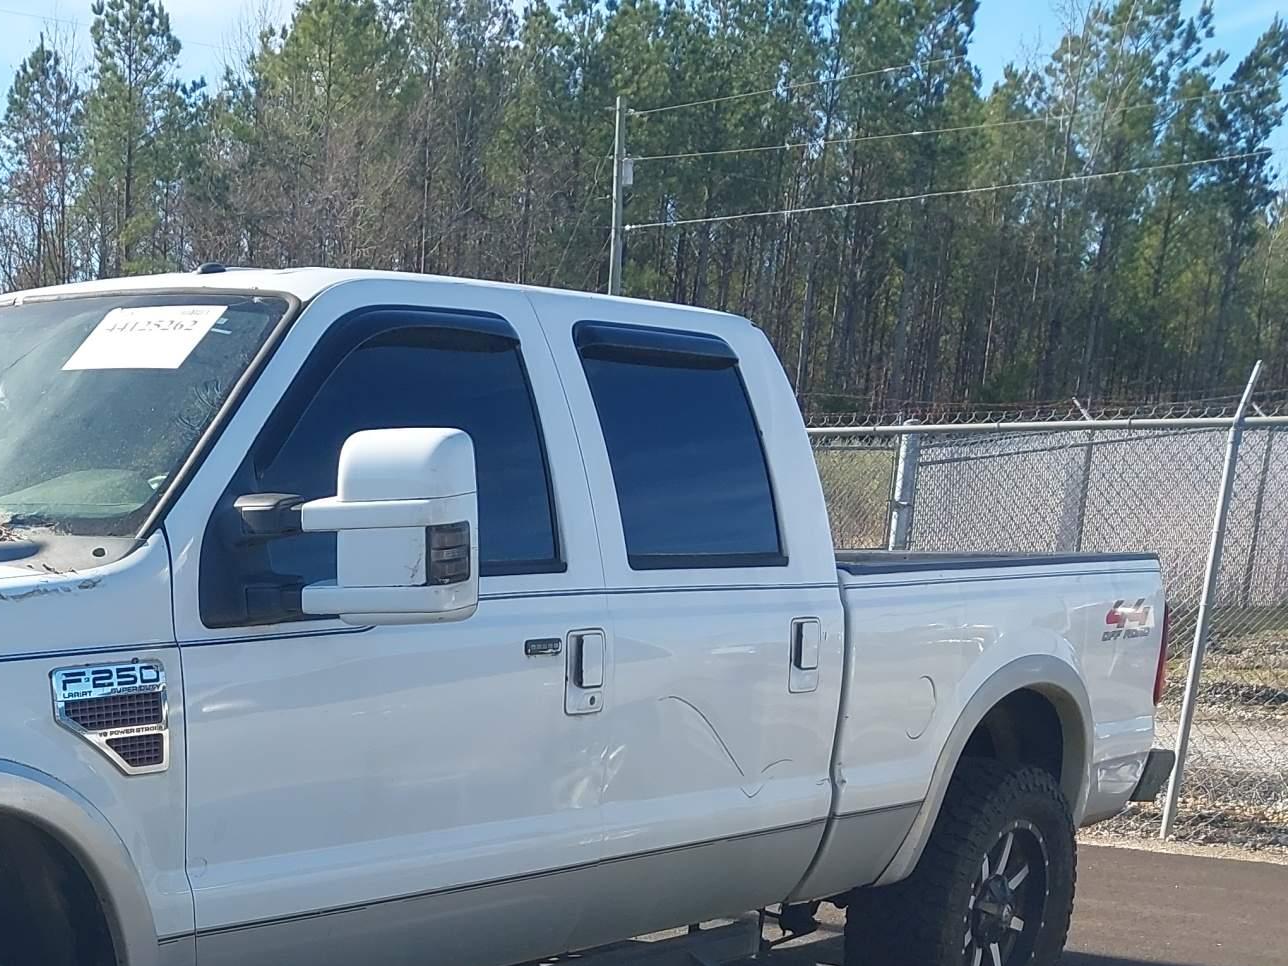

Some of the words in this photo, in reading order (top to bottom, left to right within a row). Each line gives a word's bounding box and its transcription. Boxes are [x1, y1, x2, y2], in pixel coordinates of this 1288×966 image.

[105, 319, 198, 333] 44125262
[1101, 630, 1123, 641] OFF
[62, 665, 160, 691] F-250
